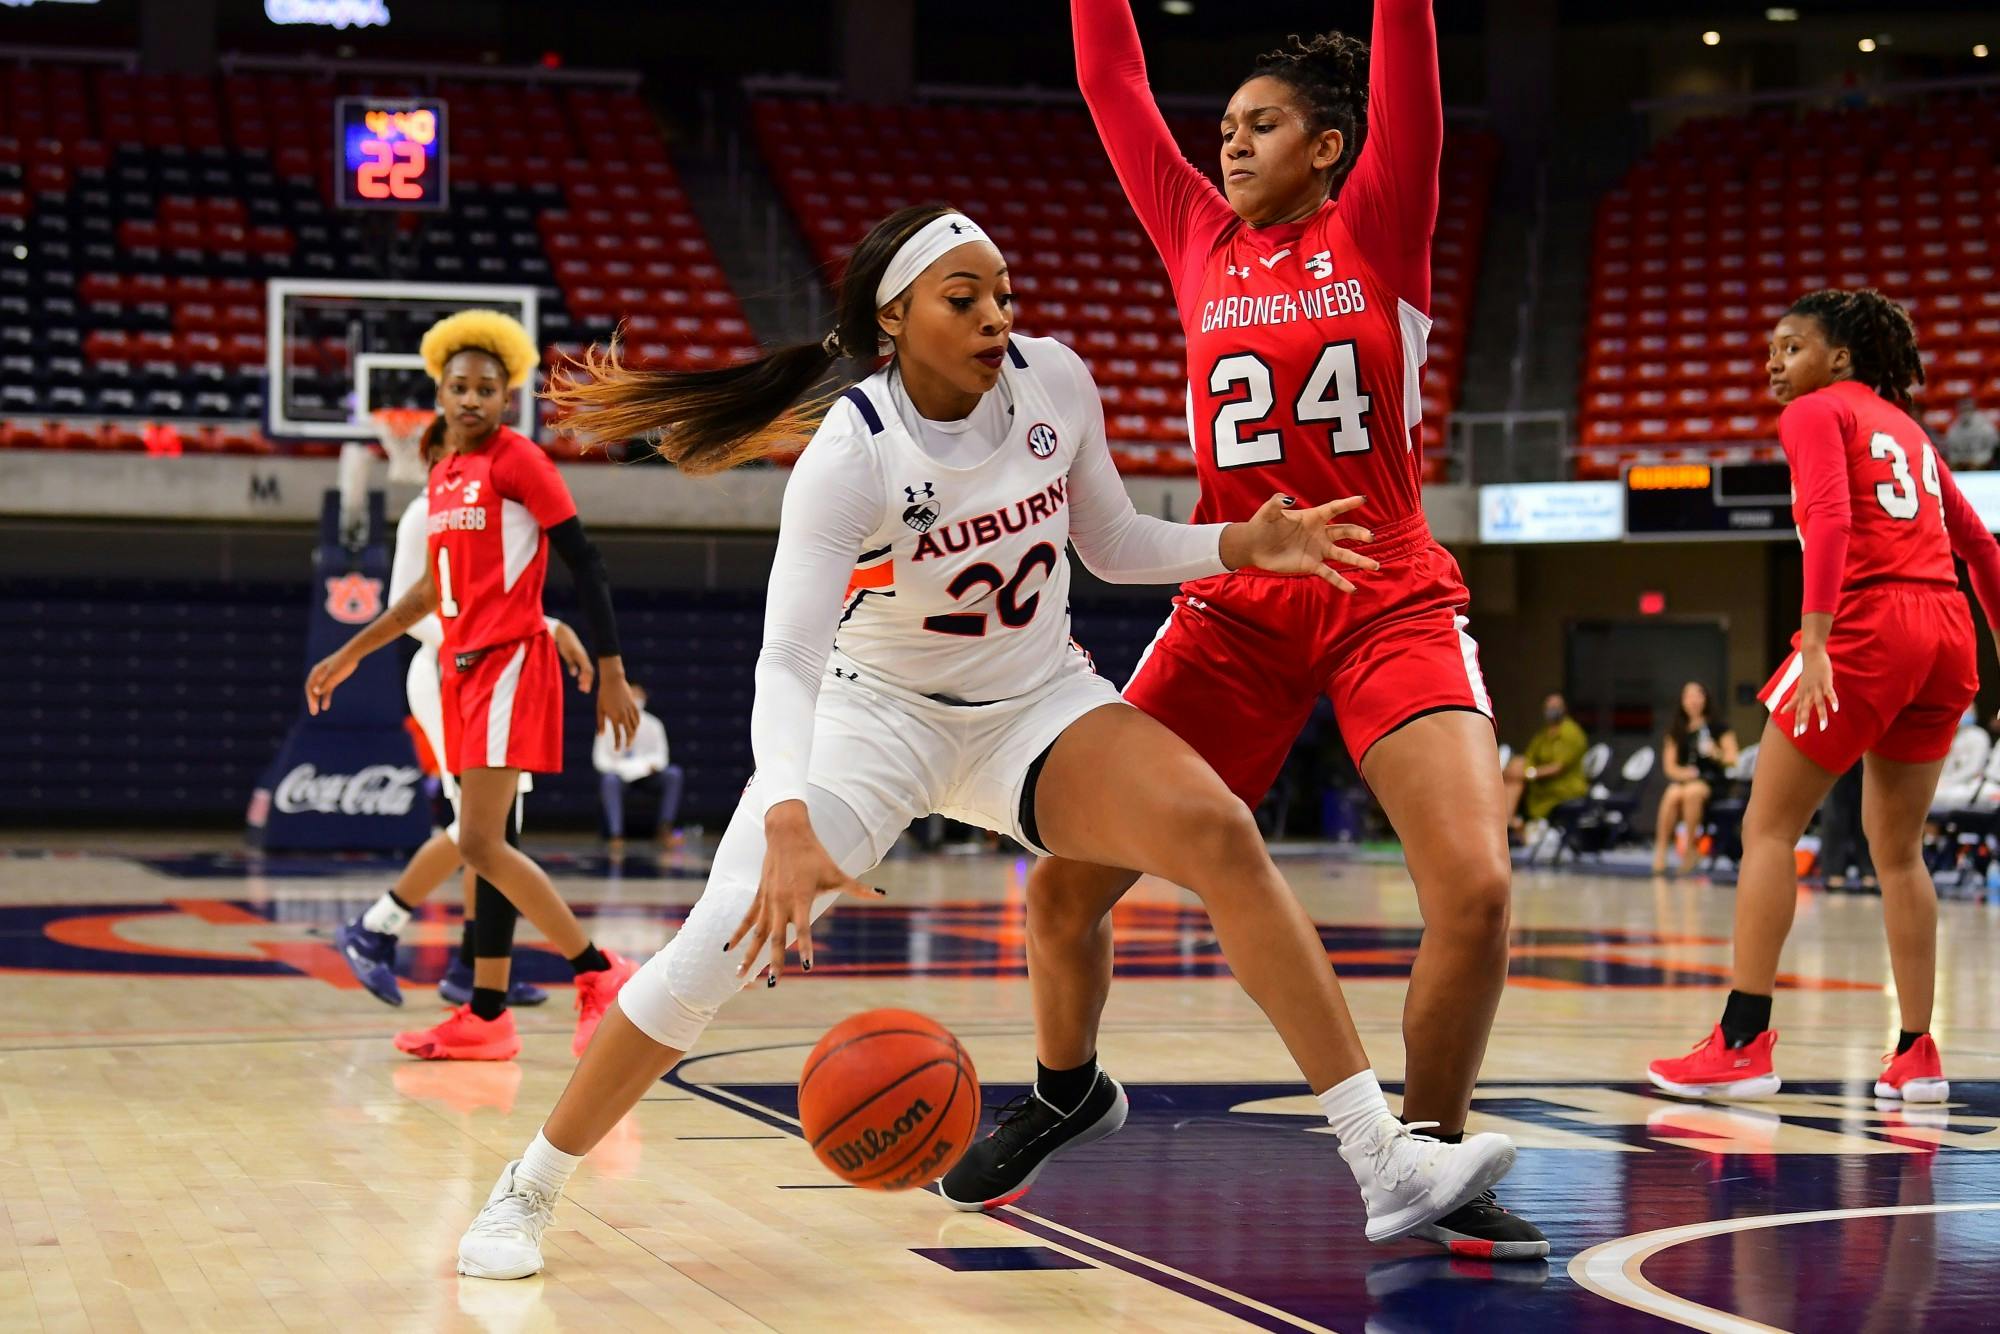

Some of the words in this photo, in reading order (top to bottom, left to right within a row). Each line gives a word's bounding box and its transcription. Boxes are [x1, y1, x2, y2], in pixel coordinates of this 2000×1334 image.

[358, 140, 425, 199] 22
[1029, 424, 1056, 457] SEC
[1208, 339, 1374, 472] 24
[1870, 431, 1947, 520] 34
[911, 476, 1066, 562] AUBURN
[438, 546, 460, 618] 1
[922, 541, 1057, 637] 20
[827, 1098, 934, 1172] Wilson
